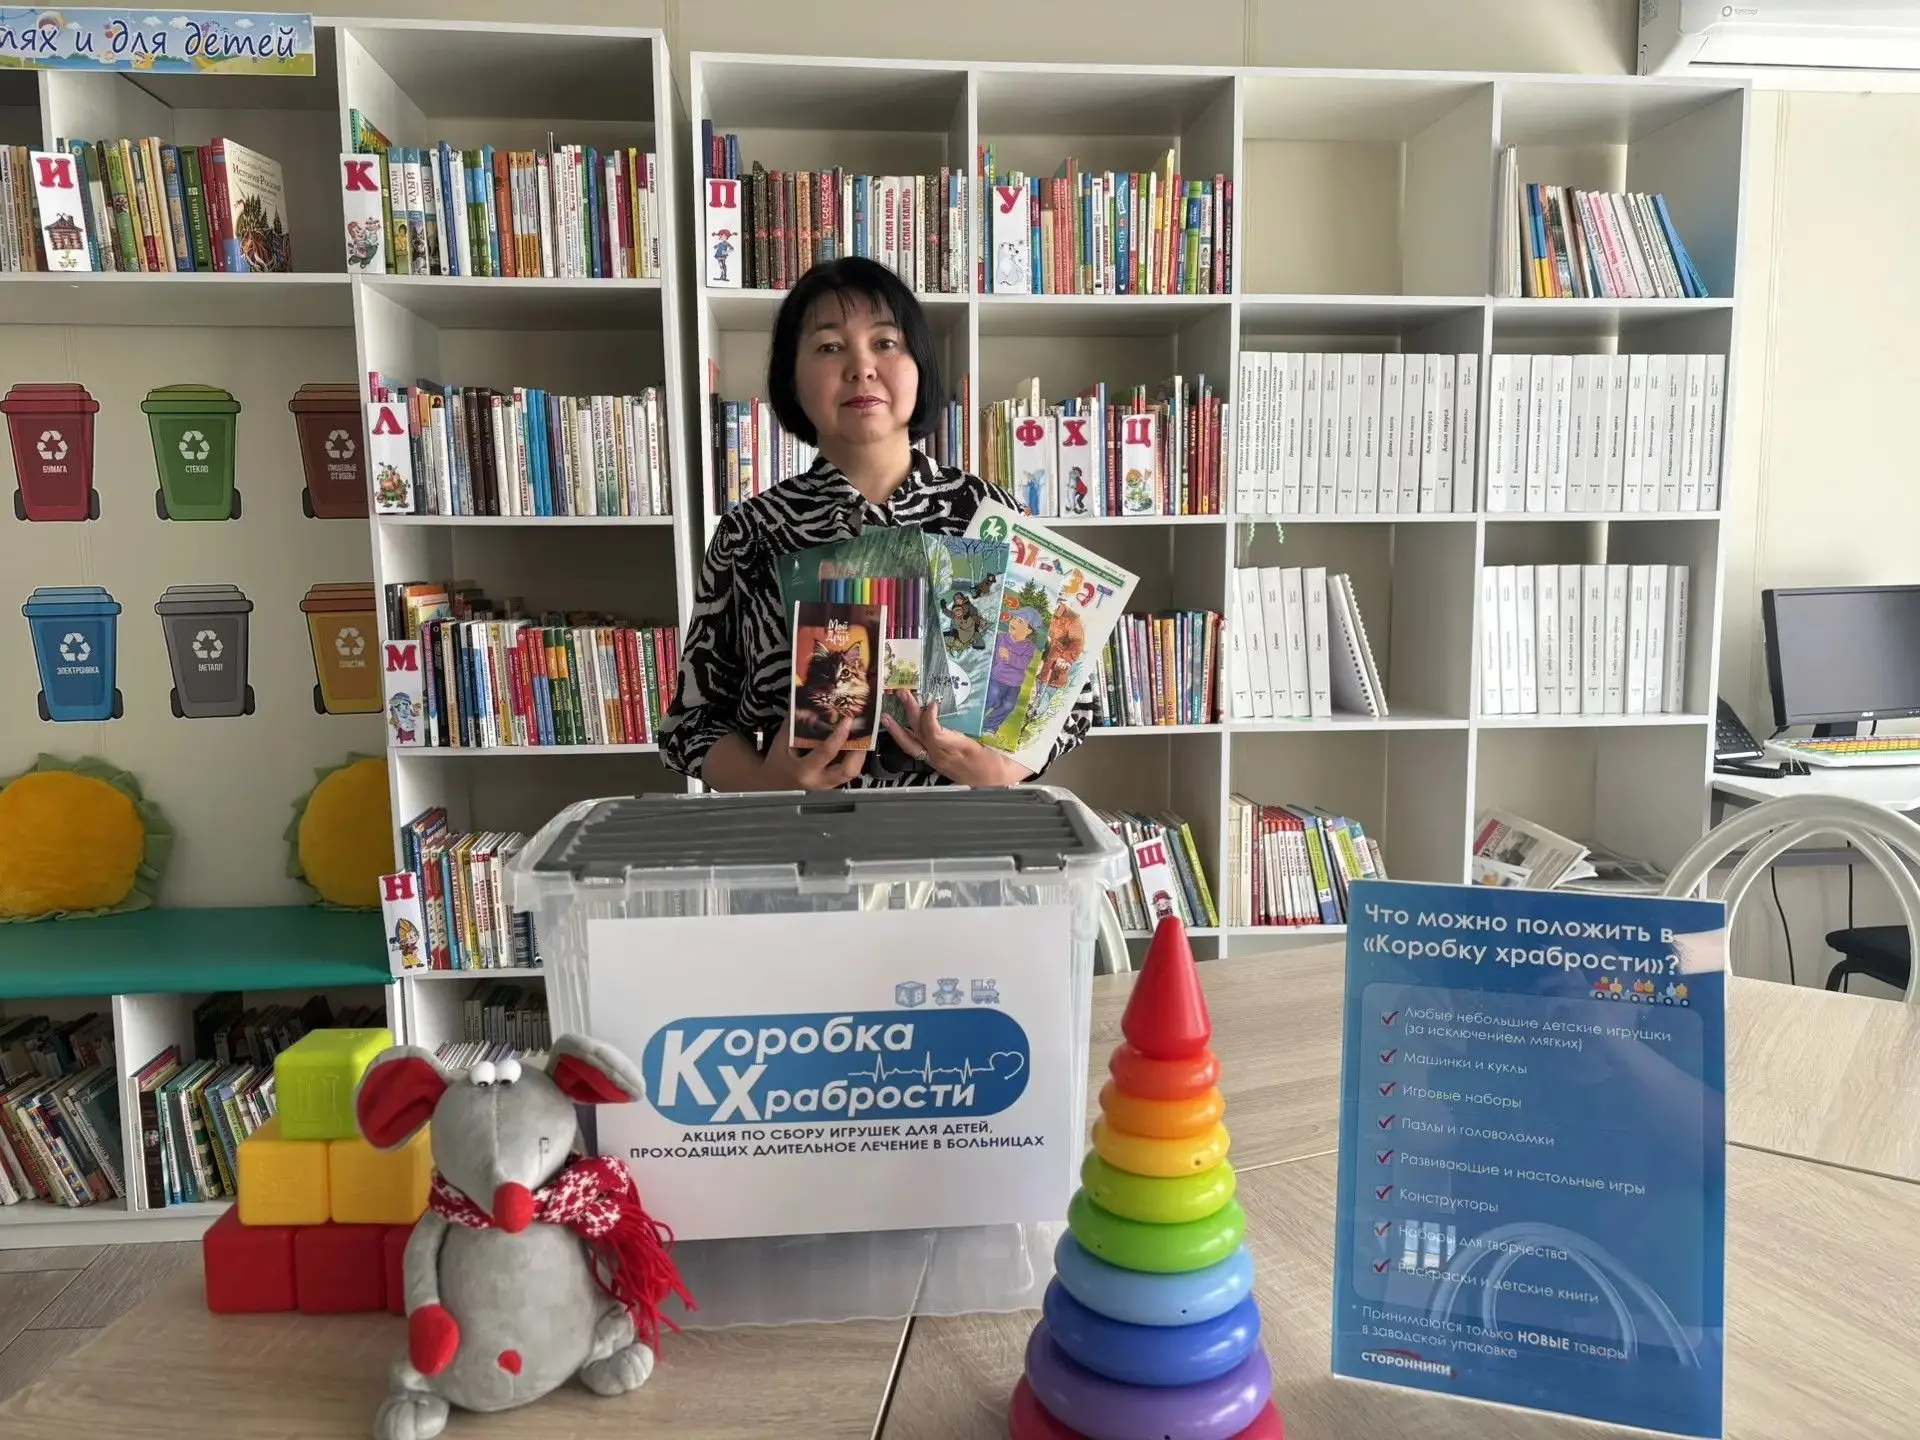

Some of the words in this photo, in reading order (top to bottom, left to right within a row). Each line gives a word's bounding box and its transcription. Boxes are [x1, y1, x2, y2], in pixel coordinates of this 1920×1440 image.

[75, 30, 94, 52] и
[111, 20, 166, 55] для
[185, 22, 295, 59] детей
[36, 157, 74, 188] И
[343, 160, 378, 191] К
[709, 180, 737, 208] П
[885, 188, 893, 219] КАПЕЛЬ
[902, 188, 910, 219] КАПЕЛЬ
[996, 186, 1023, 214] У
[885, 221, 893, 250] ЛЕСНАЯ
[902, 221, 910, 250] ЛЕСНАЯ
[372, 406, 404, 435] Л
[1016, 419, 1044, 446] Ф
[1063, 419, 1088, 447] Х
[1125, 418, 1151, 447] Ц
[1442, 409, 1450, 432] паруса
[42, 465, 68, 474] БУМАГА
[185, 465, 209, 473] СТЕКЛО
[828, 618, 849, 632] Мой
[56, 665, 100, 675] ЭЛЕКТРОНИКА
[198, 663, 223, 672] МЕТАЛЛ
[385, 644, 418, 672] М
[1136, 842, 1167, 868] Щ
[384, 873, 414, 901] Н
[1364, 904, 1409, 926] Что
[1418, 912, 1507, 932] можно
[1517, 918, 1650, 943] положить
[1661, 928, 1675, 943] в
[1364, 934, 1487, 964] «Коробку
[1496, 946, 1681, 975] храбрости»?
[1405, 1006, 1452, 1021] Любые
[1457, 1011, 1538, 1030] небольшие
[1543, 1021, 1602, 1035] детские
[1607, 1027, 1671, 1043] игрушки
[1405, 1023, 1424, 1037] (за
[1428, 1027, 1525, 1046] исключением
[1530, 1036, 1584, 1052] мягких)
[657, 1016, 914, 1108] Коробка
[1405, 1053, 1471, 1069] Машинки
[1476, 1061, 1484, 1069] и
[1488, 1062, 1528, 1075] куклы
[709, 1065, 975, 1122] Храбрости
[1403, 1085, 1460, 1102] Игровые
[1465, 1092, 1522, 1109] наборы
[682, 1128, 737, 1143] АКЦИЯ
[741, 1129, 765, 1142] ПО
[771, 1127, 825, 1141] СБОРУ
[830, 1125, 901, 1139] ИГРУШЕК
[905, 1123, 938, 1137] ДЛЯ
[942, 1120, 993, 1136] ДЕТЕЙ,
[1402, 1118, 1444, 1134] Пазлы
[1448, 1125, 1456, 1134] и
[1460, 1126, 1555, 1146] головоломки
[630, 1144, 748, 1160] ПРОХОДЯЩИХ
[753, 1142, 856, 1156] ДЛИТЕЛЬНОЕ
[860, 1139, 929, 1153] ЛЕЧЕНИЕ
[933, 1138, 942, 1150] В
[947, 1135, 1044, 1151] БОЛЬНИЦАХ
[1401, 1153, 1500, 1176] Развивающие
[1504, 1168, 1512, 1177] и
[1517, 1170, 1604, 1190] настольные
[1609, 1181, 1645, 1196] игры
[1400, 1188, 1498, 1213] Конструкторы
[1400, 1226, 1455, 1246] Наборы
[1460, 1238, 1482, 1250] для
[1488, 1240, 1567, 1262] творчества
[1399, 1263, 1476, 1286] Раскраски
[1481, 1277, 1489, 1286] и
[1493, 1279, 1553, 1298] детские
[1558, 1288, 1599, 1304] книги
[1362, 1306, 1462, 1333] Принимаются
[1466, 1324, 1513, 1341] только
[1517, 1331, 1570, 1350] НОВЫЕ
[1574, 1341, 1628, 1361] товары
[1362, 1325, 1369, 1334] в
[1373, 1326, 1446, 1348] заводской
[1451, 1340, 1517, 1359] упаковке
[1361, 1351, 1451, 1377] СТОРОННИКИ
